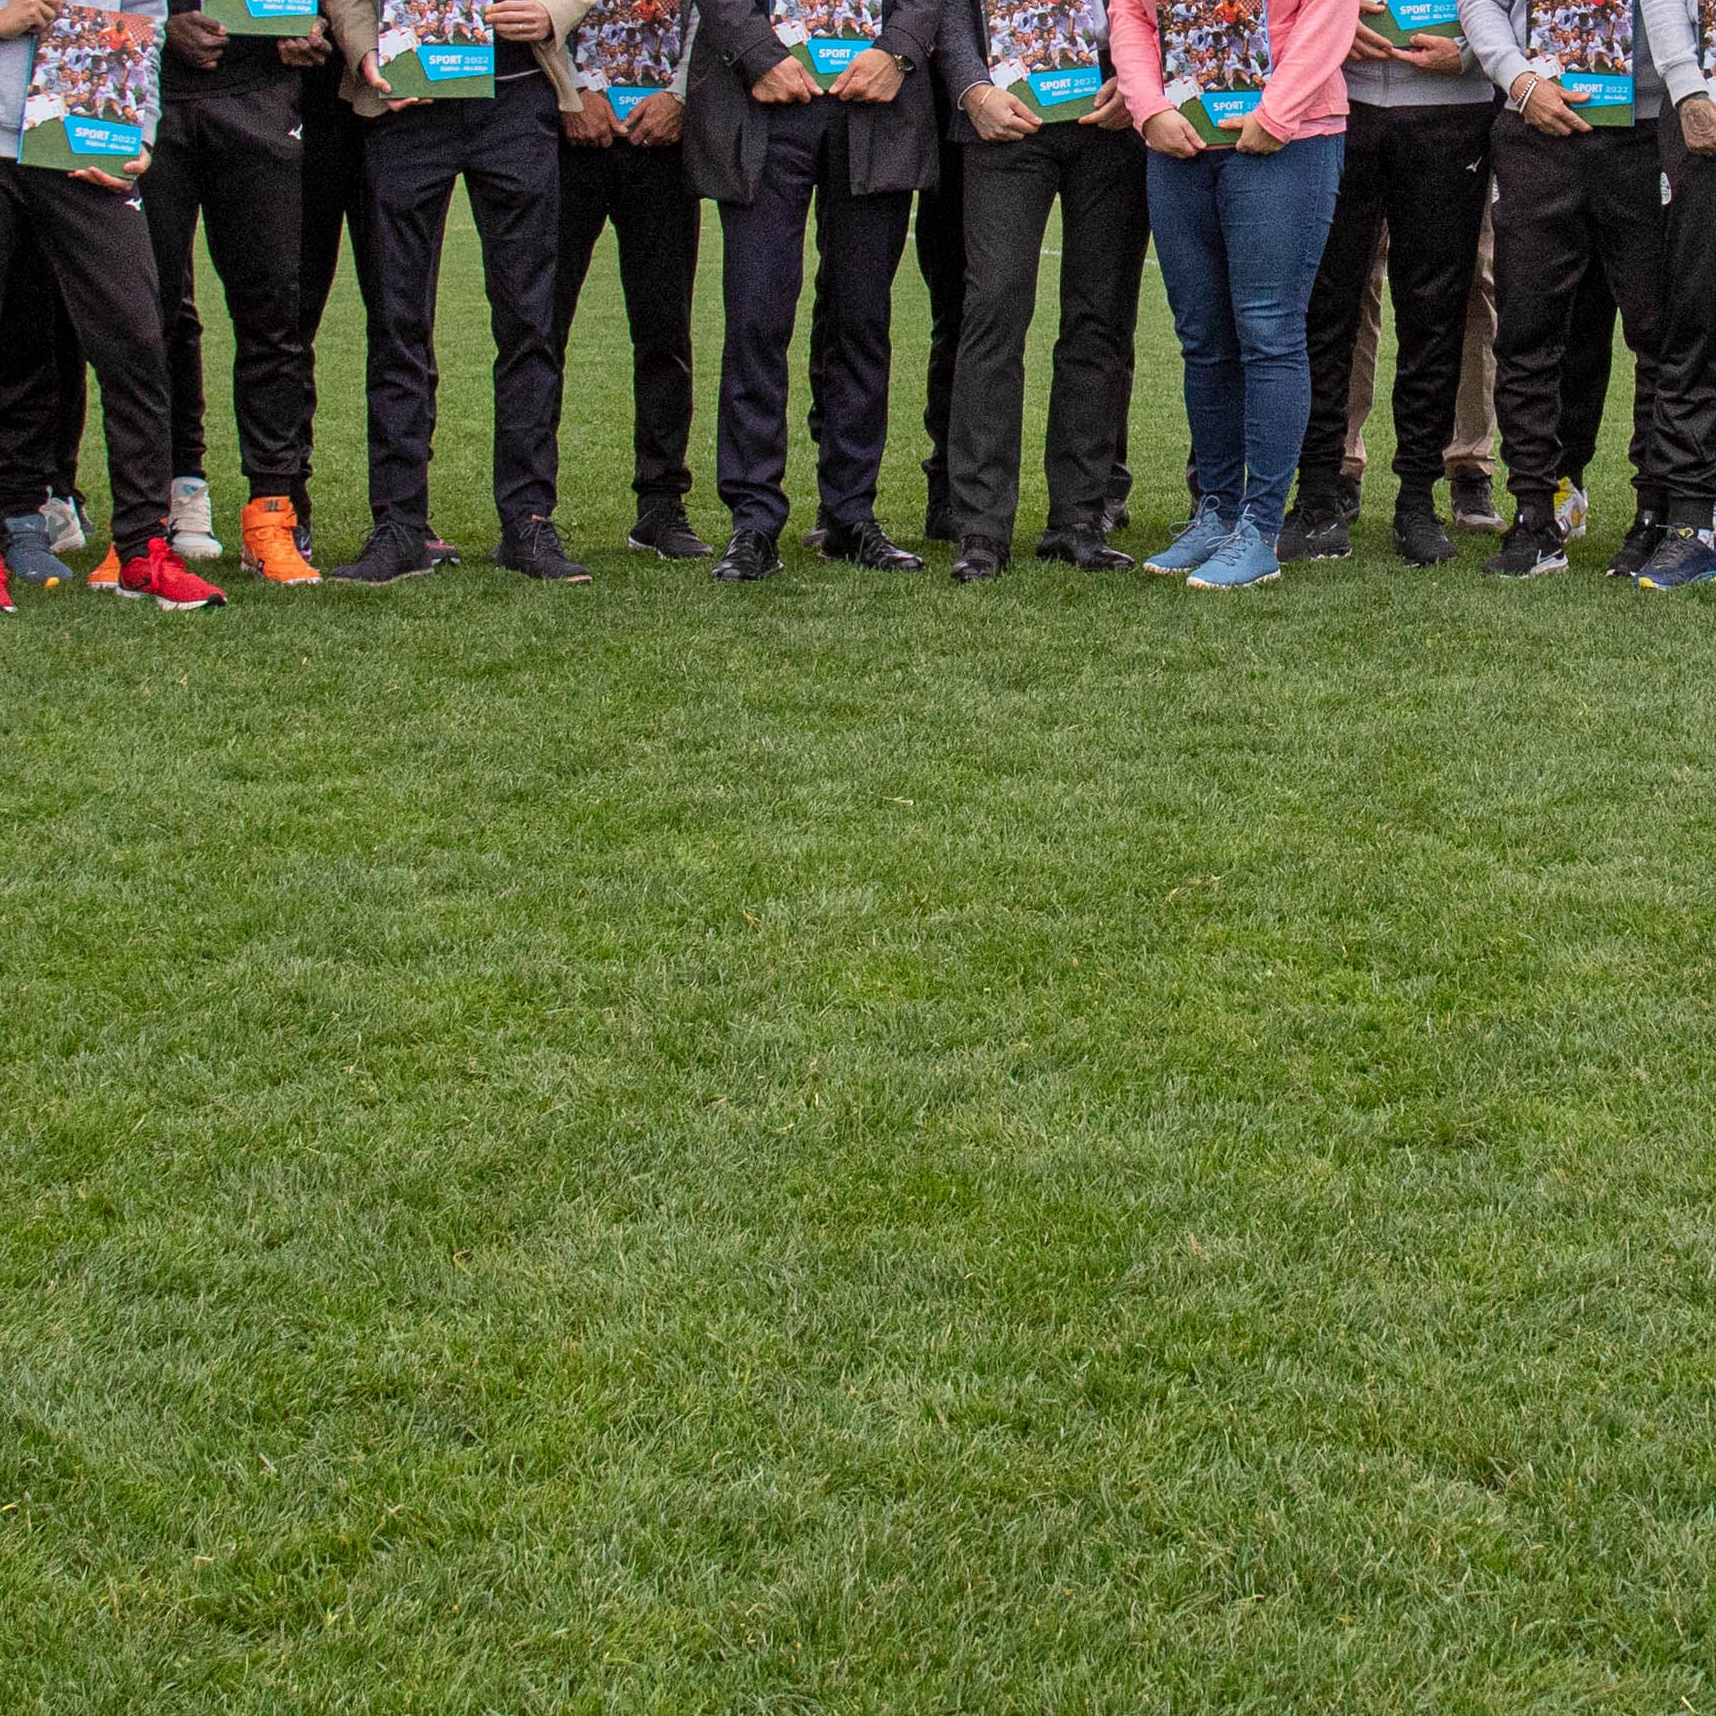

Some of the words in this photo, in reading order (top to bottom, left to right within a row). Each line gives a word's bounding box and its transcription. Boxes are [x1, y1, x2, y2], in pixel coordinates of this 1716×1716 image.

[1400, 4, 1431, 15] SPORT
[1433, 3, 1456, 12] 2022
[819, 48, 851, 58] SPORT
[428, 54, 463, 65] SPORT
[464, 56, 489, 64] 2022
[1039, 78, 1071, 91] SPORT
[1073, 77, 1097, 87] 2022
[1572, 83, 1603, 94] SPORT
[619, 96, 646, 105] SPO
[1213, 101, 1244, 112] SPORT
[75, 127, 110, 141] SPORT
[111, 134, 137, 145] 2022
